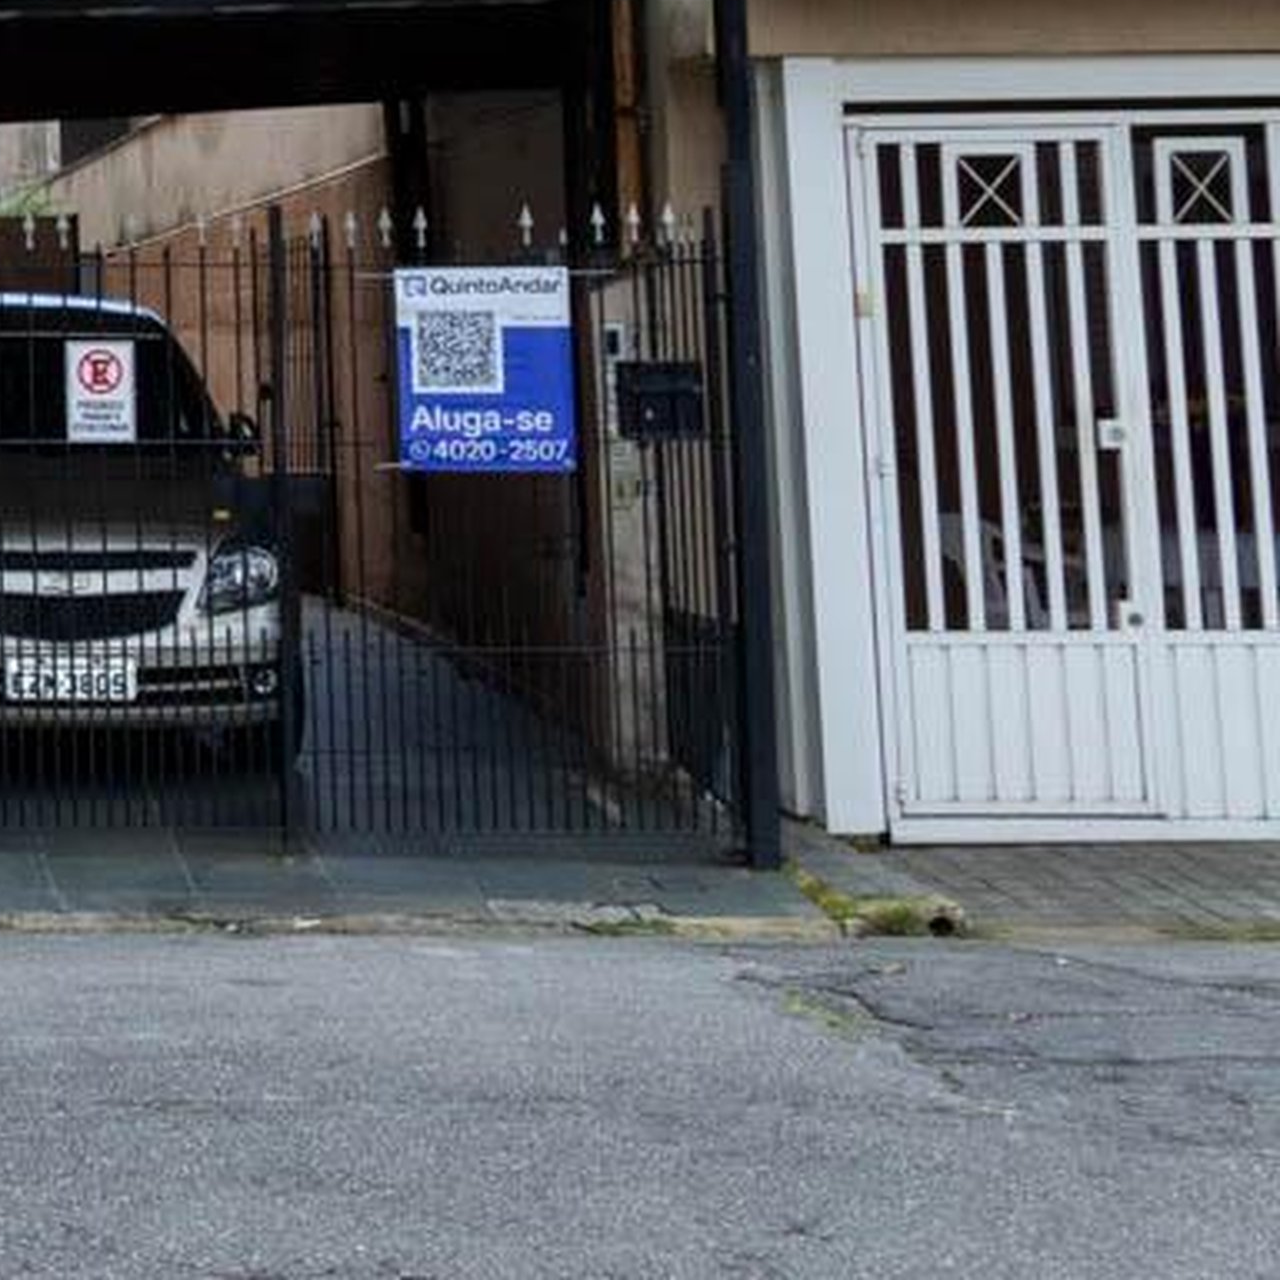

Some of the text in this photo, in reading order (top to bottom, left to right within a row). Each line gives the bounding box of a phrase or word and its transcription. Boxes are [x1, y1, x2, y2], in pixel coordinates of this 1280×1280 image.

[429, 276, 562, 295] QuintoAndar
[410, 405, 553, 437] Aluga-se
[433, 440, 568, 461] 4020-2507
